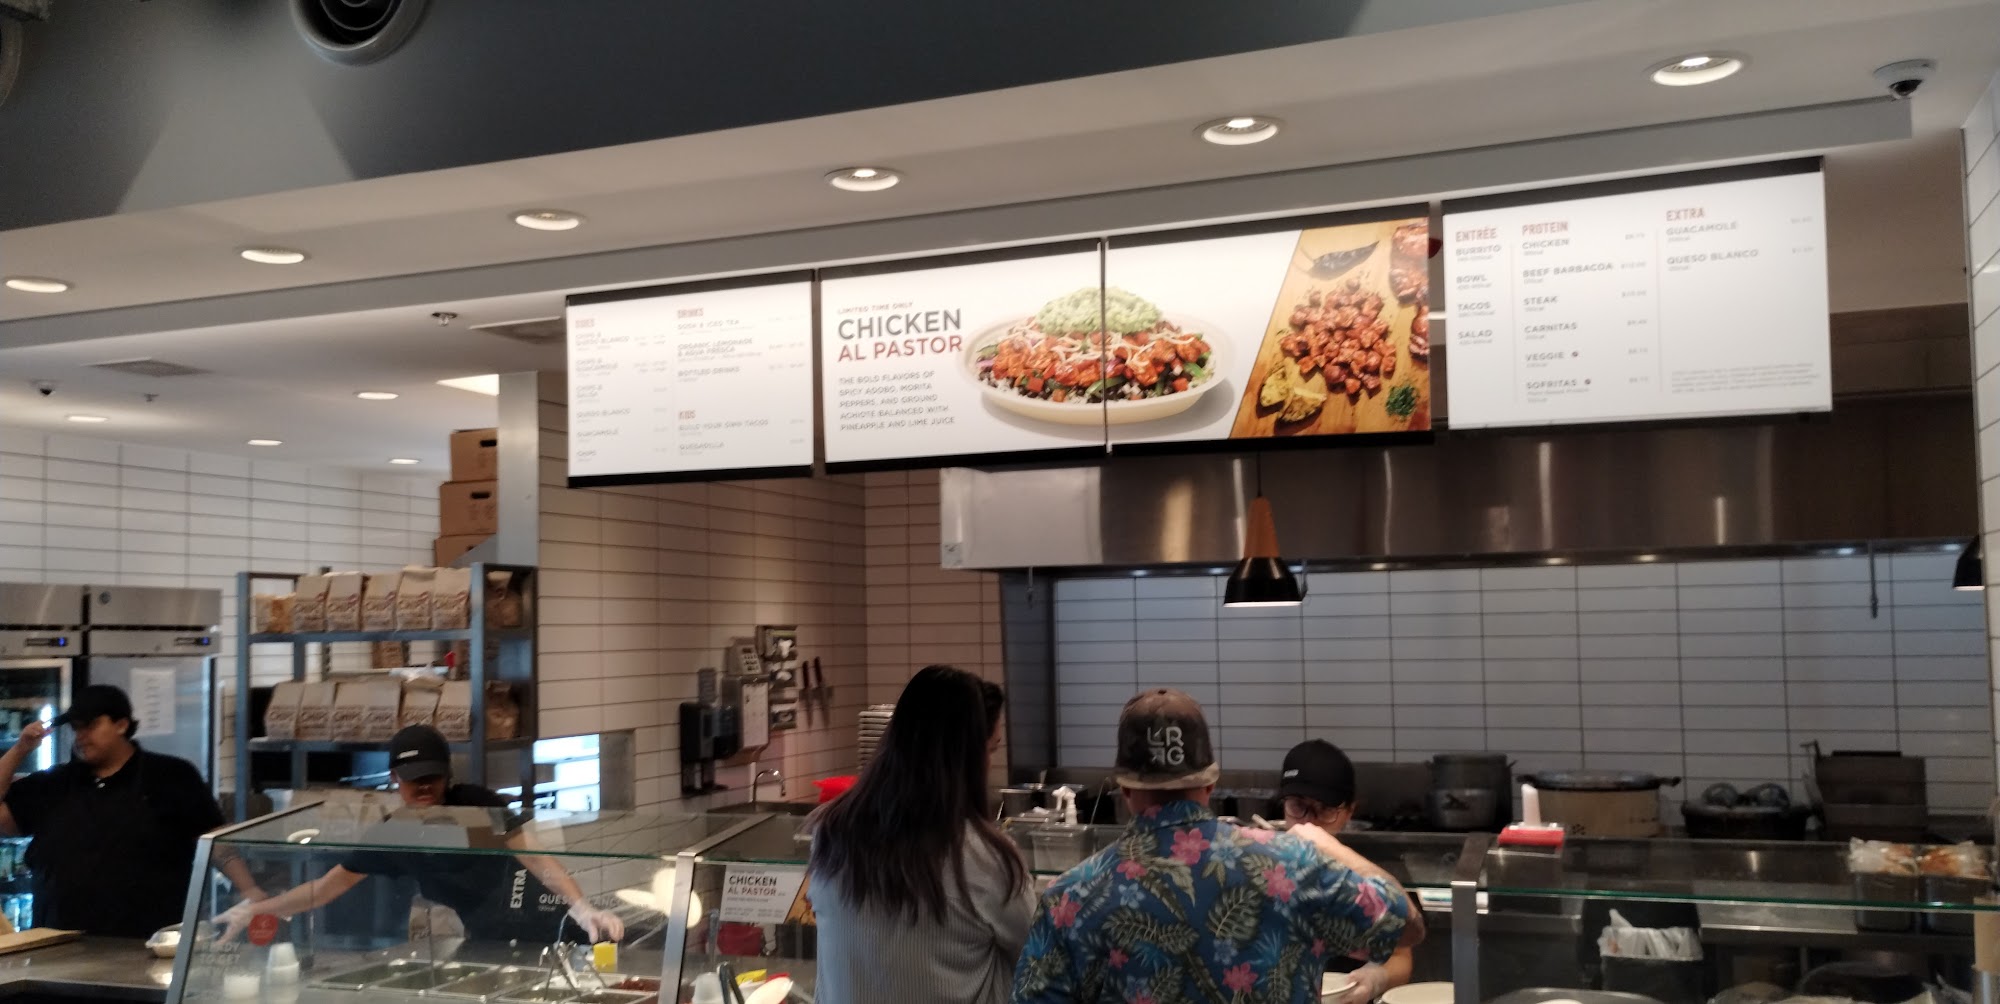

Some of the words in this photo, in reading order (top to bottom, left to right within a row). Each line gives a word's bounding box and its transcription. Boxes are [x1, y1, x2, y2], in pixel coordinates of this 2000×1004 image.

[1666, 208, 1704, 221] EXTRA
[1522, 221, 1568, 235] PROTEIN
[1666, 222, 1737, 235] GUACAMOLE
[1522, 239, 1569, 249] CHICKEN
[1456, 244, 1501, 255] BURRITO
[1667, 254, 1706, 265] QUESO
[1710, 249, 1759, 260] BLANCO
[1523, 268, 1549, 277] BEEF
[1554, 263, 1613, 274] BARBACOA
[1456, 275, 1487, 283] BOWL
[1523, 296, 1558, 305] STEAK
[838, 306, 868, 314] LIMITED
[892, 302, 913, 310] ONLY
[1458, 302, 1491, 311] TACOS
[838, 309, 961, 340] CHICKEN
[1524, 323, 1577, 333] CARNITAS
[1458, 330, 1492, 339] SALAD
[838, 344, 866, 362] AL
[874, 336, 962, 359] PASTOR
[1525, 352, 1564, 361] VEGGIE
[840, 376, 854, 384] THE
[857, 375, 879, 383] BOLD
[882, 373, 920, 381] FLAVORS
[1526, 380, 1577, 389] SOFRITAS
[840, 388, 862, 396] SPICY
[901, 395, 938, 403] GROUND
[679, 410, 696, 420] KIDS
[840, 411, 876, 420] ACHIOTE
[879, 408, 923, 416] BALANCED
[840, 422, 885, 431] PINEAPPLE
[729, 875, 777, 886] CHICKEN
[510, 869, 527, 908] EXTRA
[742, 886, 777, 896] PASTOR
